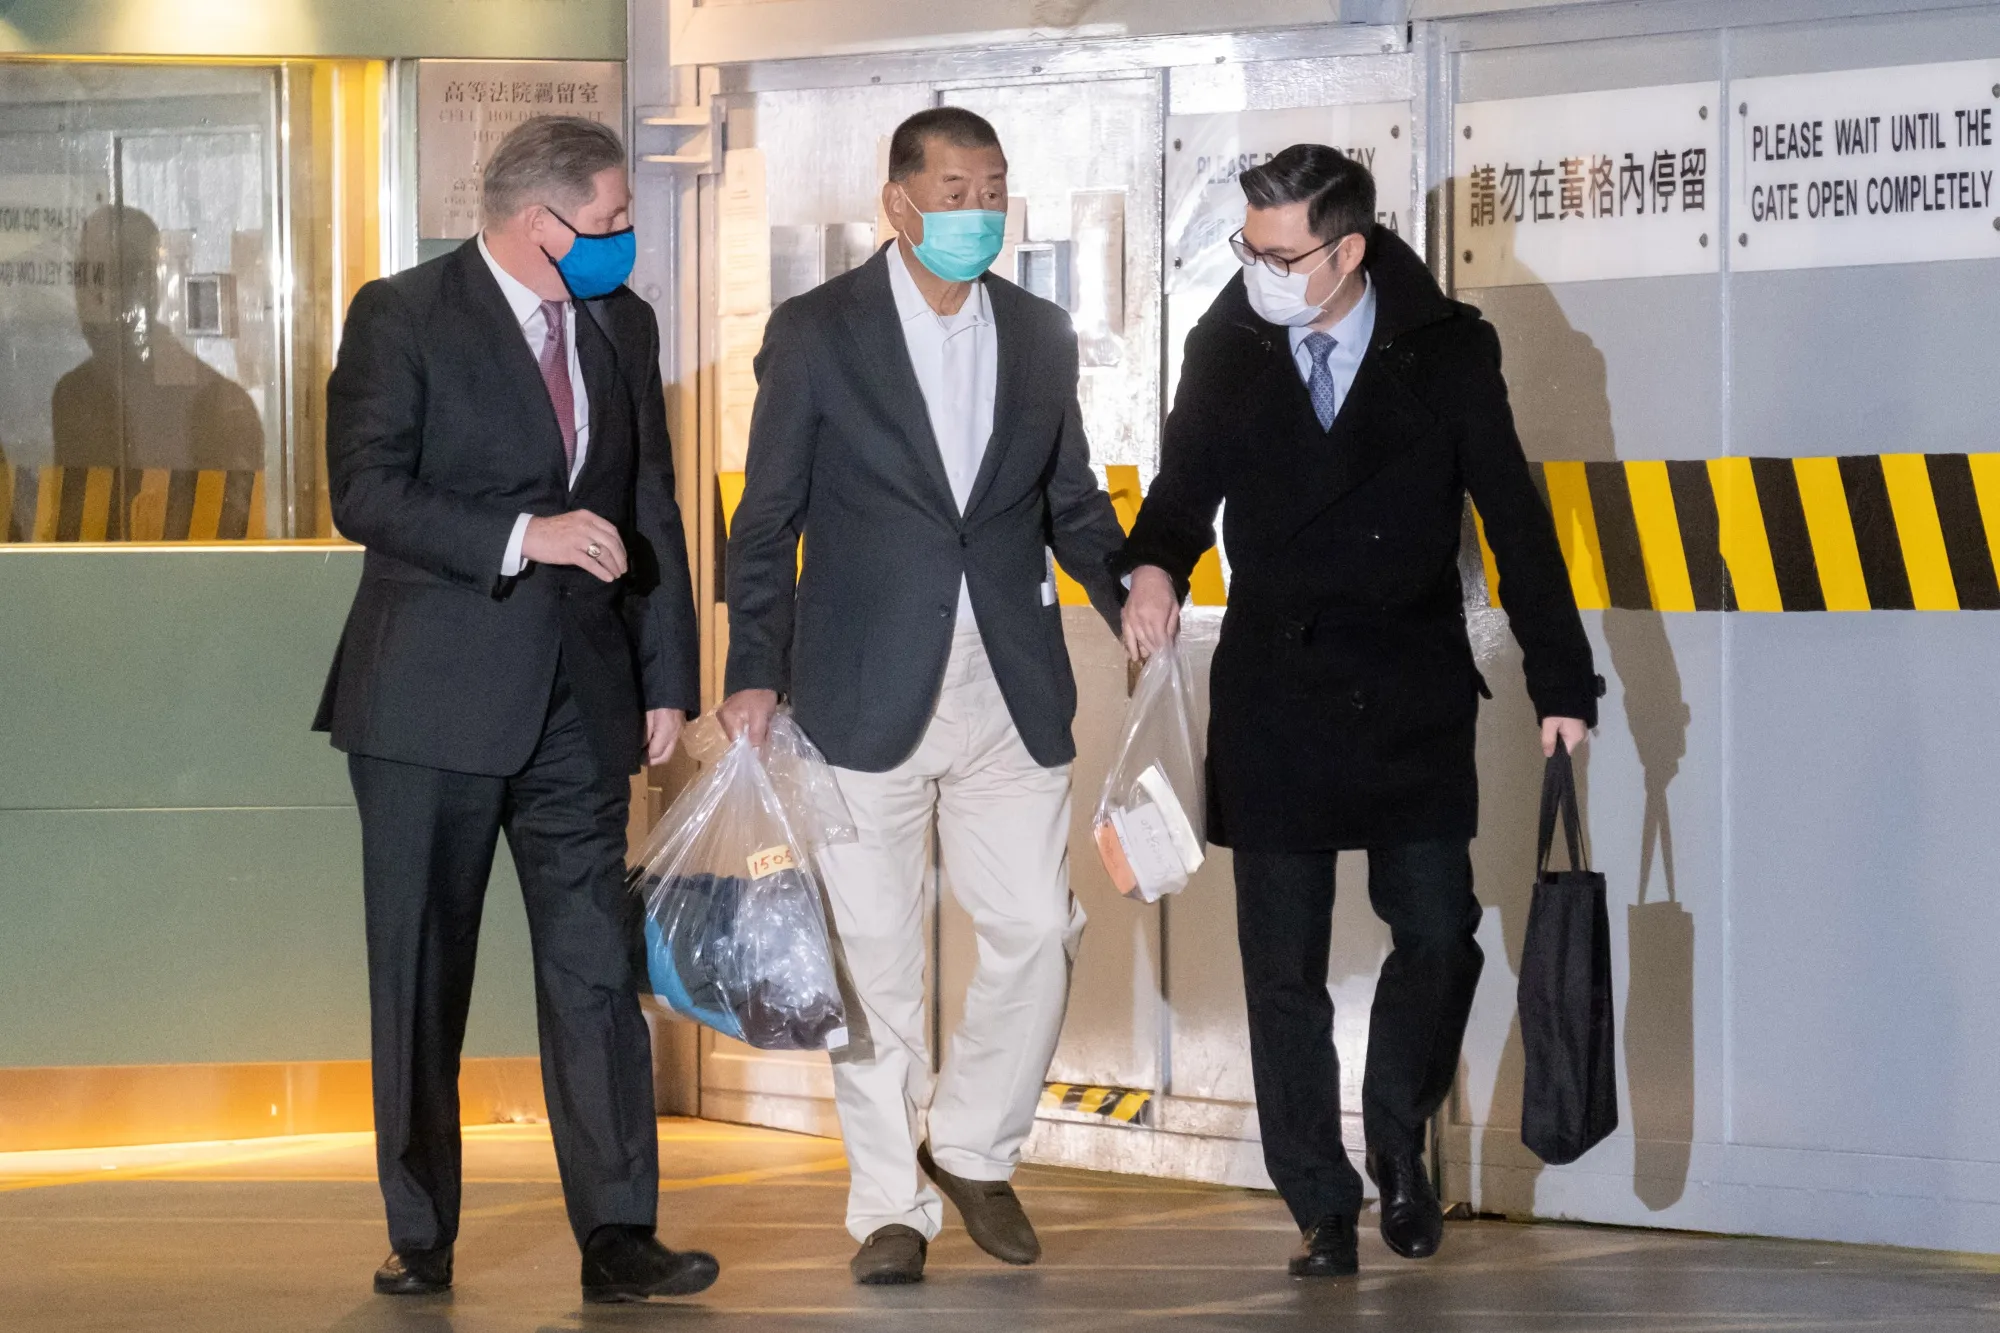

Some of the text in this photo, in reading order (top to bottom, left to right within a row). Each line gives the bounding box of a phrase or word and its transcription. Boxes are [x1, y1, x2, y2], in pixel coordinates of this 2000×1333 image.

[1753, 108, 1992, 161] PLEASE WAIT UNTIL THE
[1470, 148, 1707, 227] 請勿在黃格內停留
[1751, 170, 1993, 222] GATE OPEN COMPLETELY
